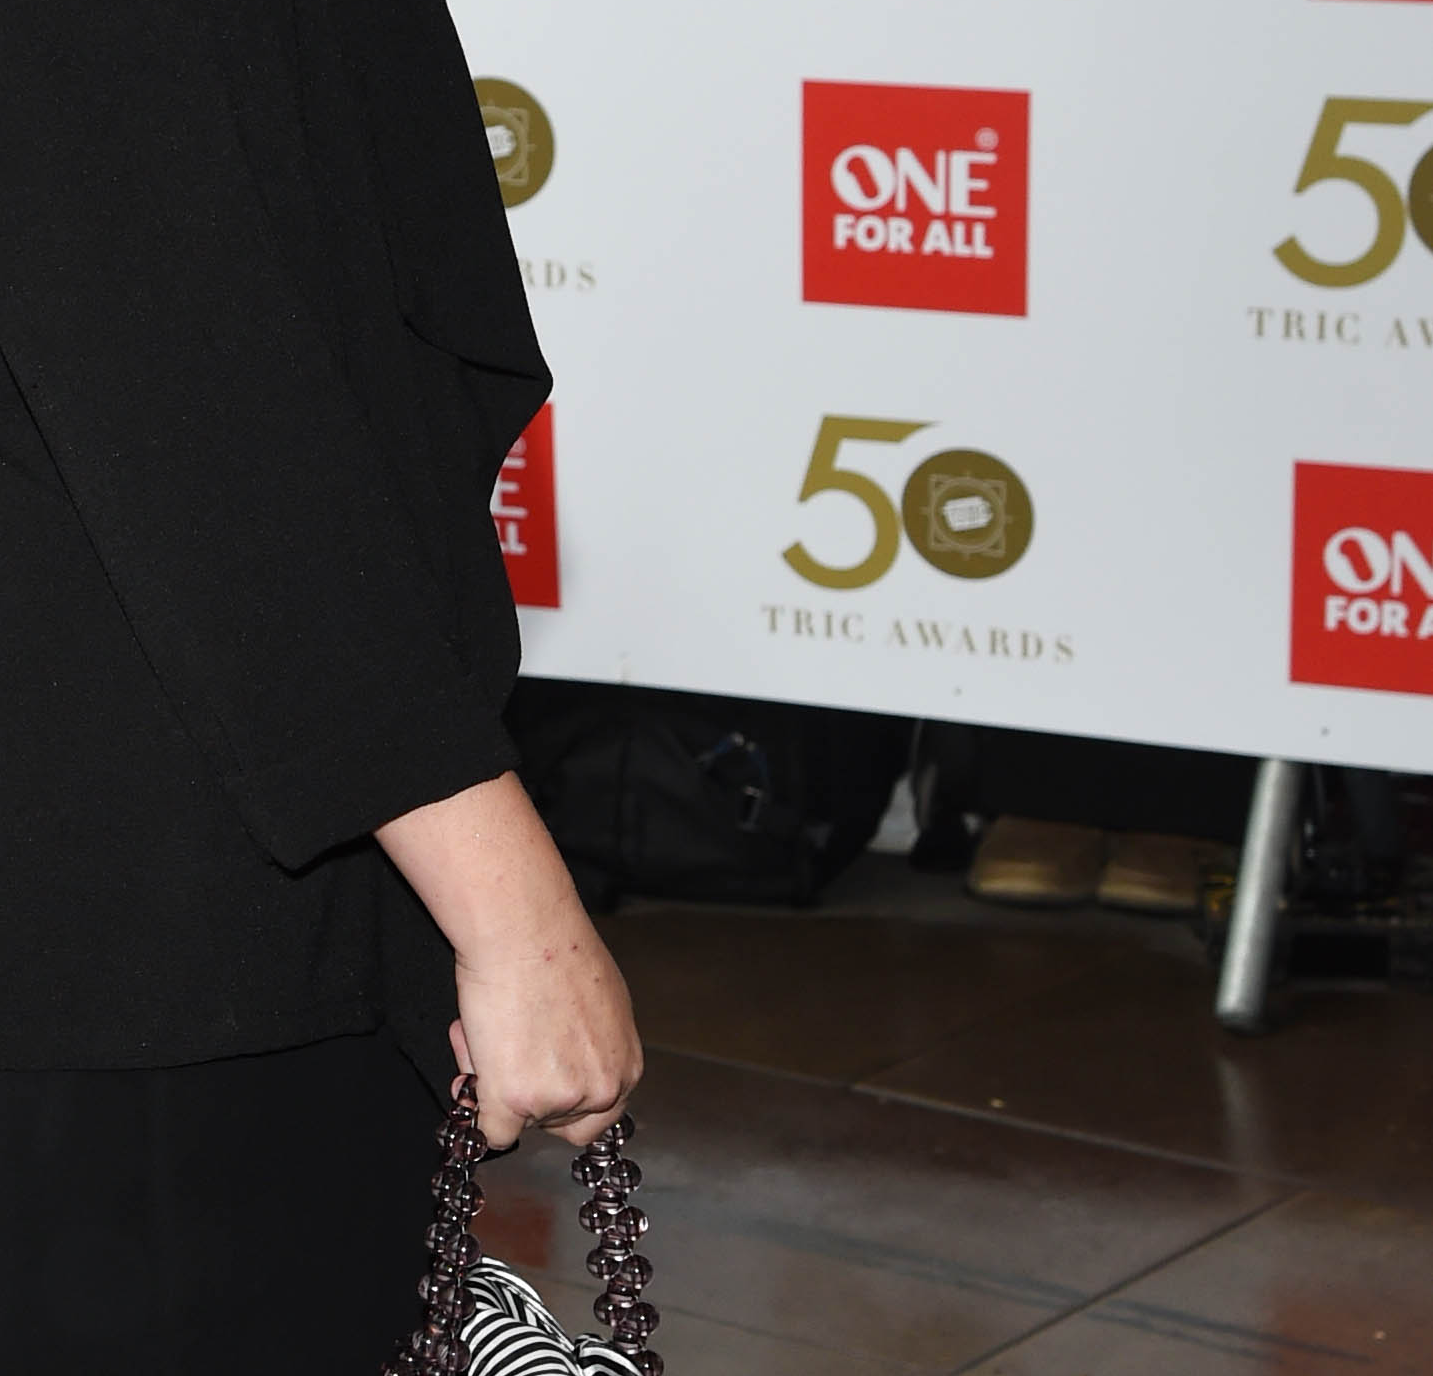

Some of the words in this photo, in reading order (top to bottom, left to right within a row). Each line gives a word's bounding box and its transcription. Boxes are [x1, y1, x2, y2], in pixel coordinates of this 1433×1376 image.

[830, 144, 998, 219] ONE
[833, 213, 914, 254] FOR
[921, 219, 994, 260] ALL
[521, 256, 598, 293] RDS
[1246, 305, 1363, 348] TRIC
[1323, 526, 1433, 601] ON
[760, 603, 865, 643] TRIC
[887, 617, 1077, 665] AWARDS
[1324, 594, 1410, 638] FOR
